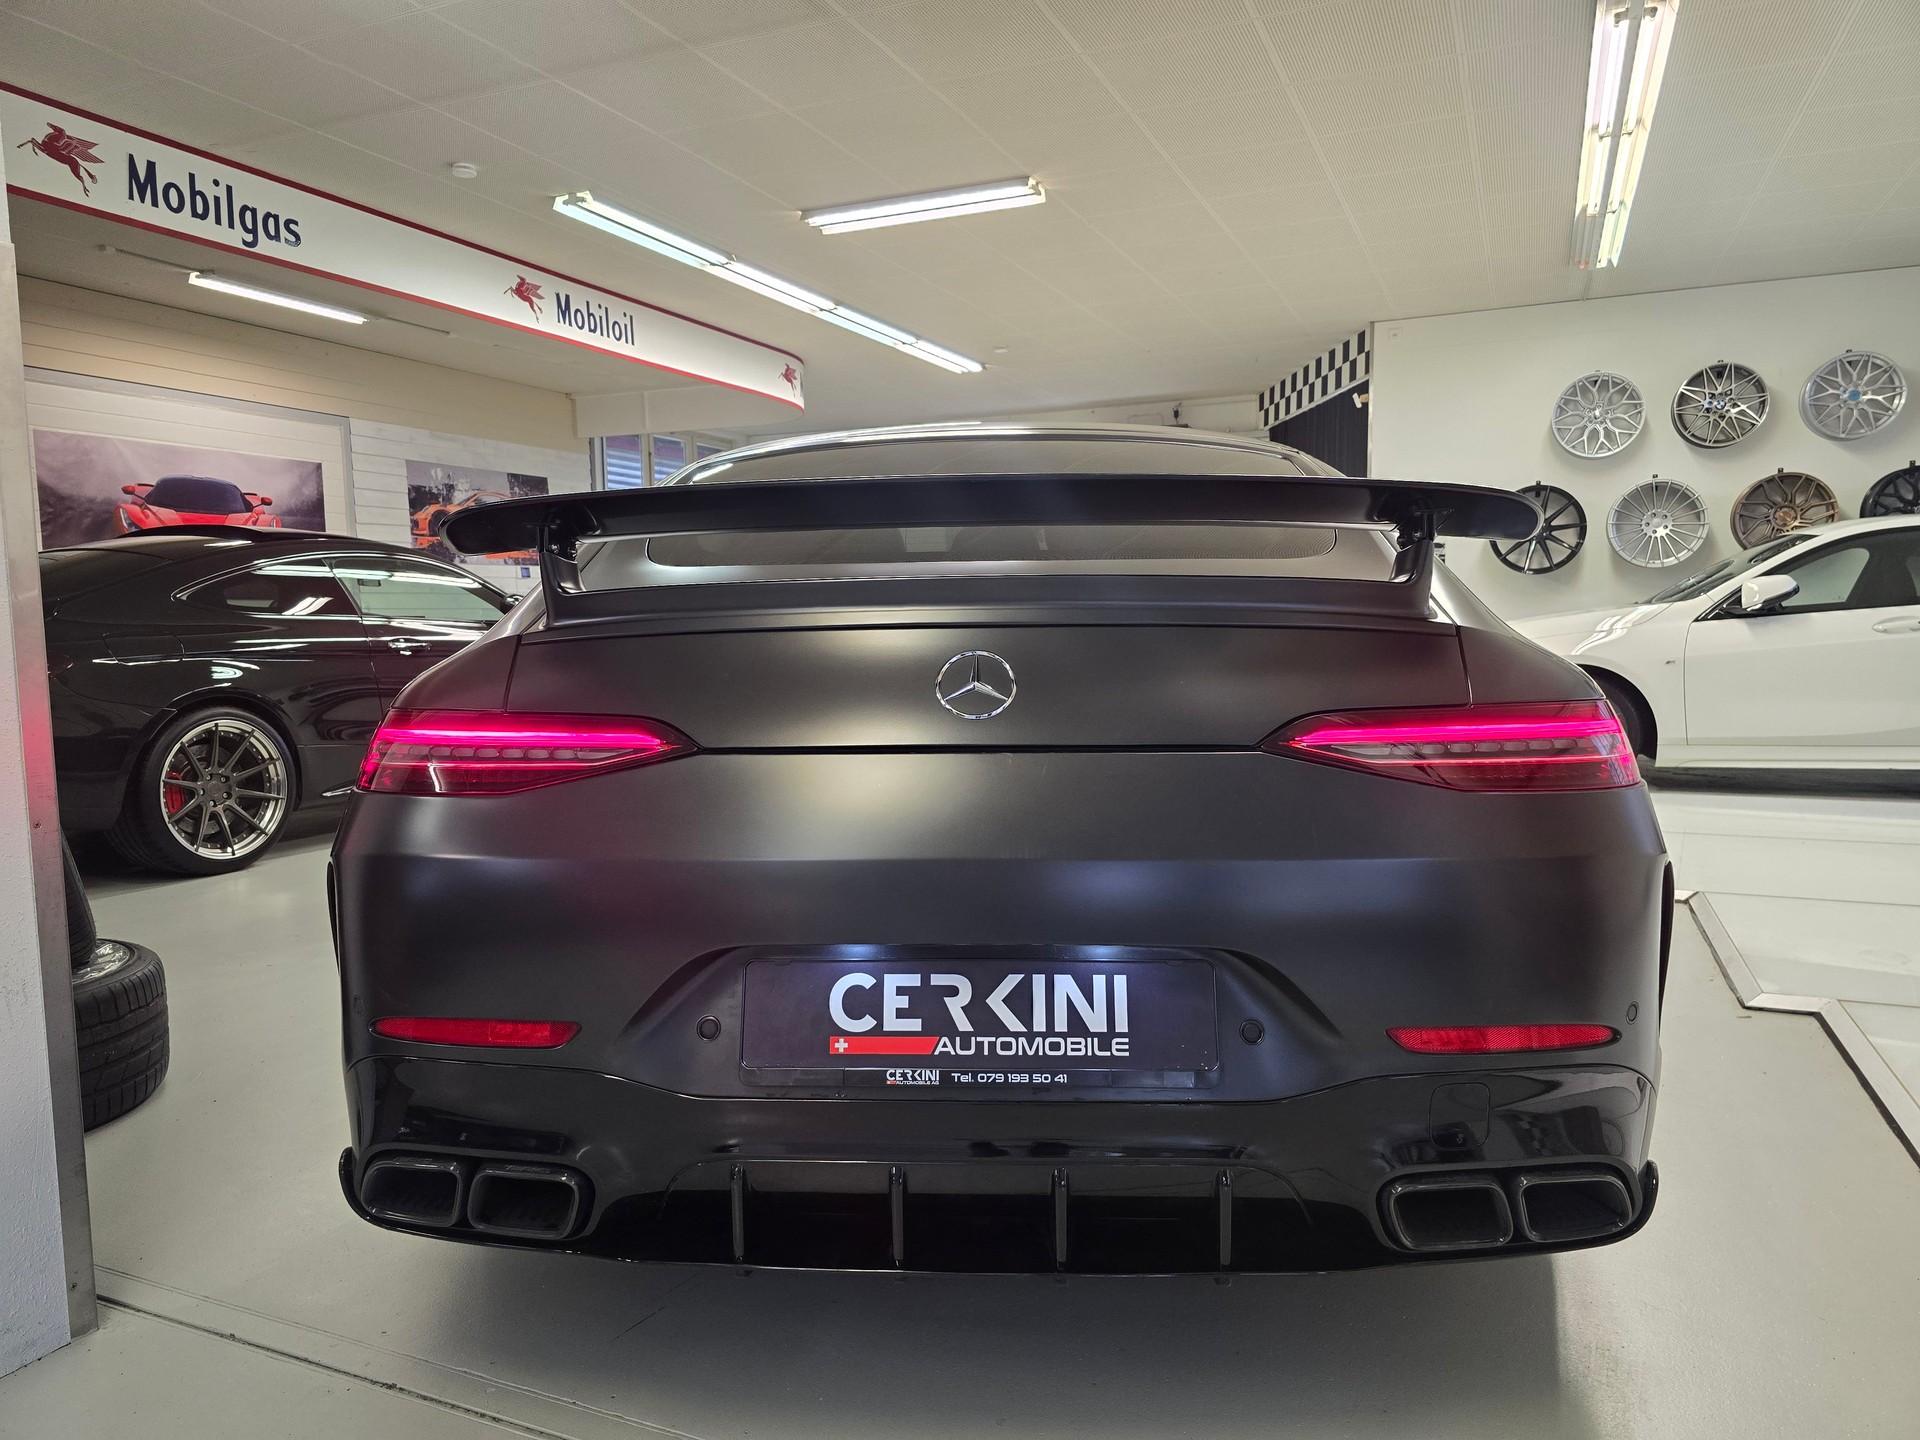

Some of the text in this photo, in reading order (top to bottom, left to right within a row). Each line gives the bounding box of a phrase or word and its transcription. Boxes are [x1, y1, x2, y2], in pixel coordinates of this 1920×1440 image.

[128, 153, 302, 248] Mobilgas
[555, 291, 635, 346] Mobiloil
[829, 972, 1129, 1032] CERKINI
[934, 1037, 1130, 1056] AUTOMOBILE
[886, 1069, 940, 1081] CERKINI
[951, 1073, 1068, 1084] Tel. 079 193 50 41
